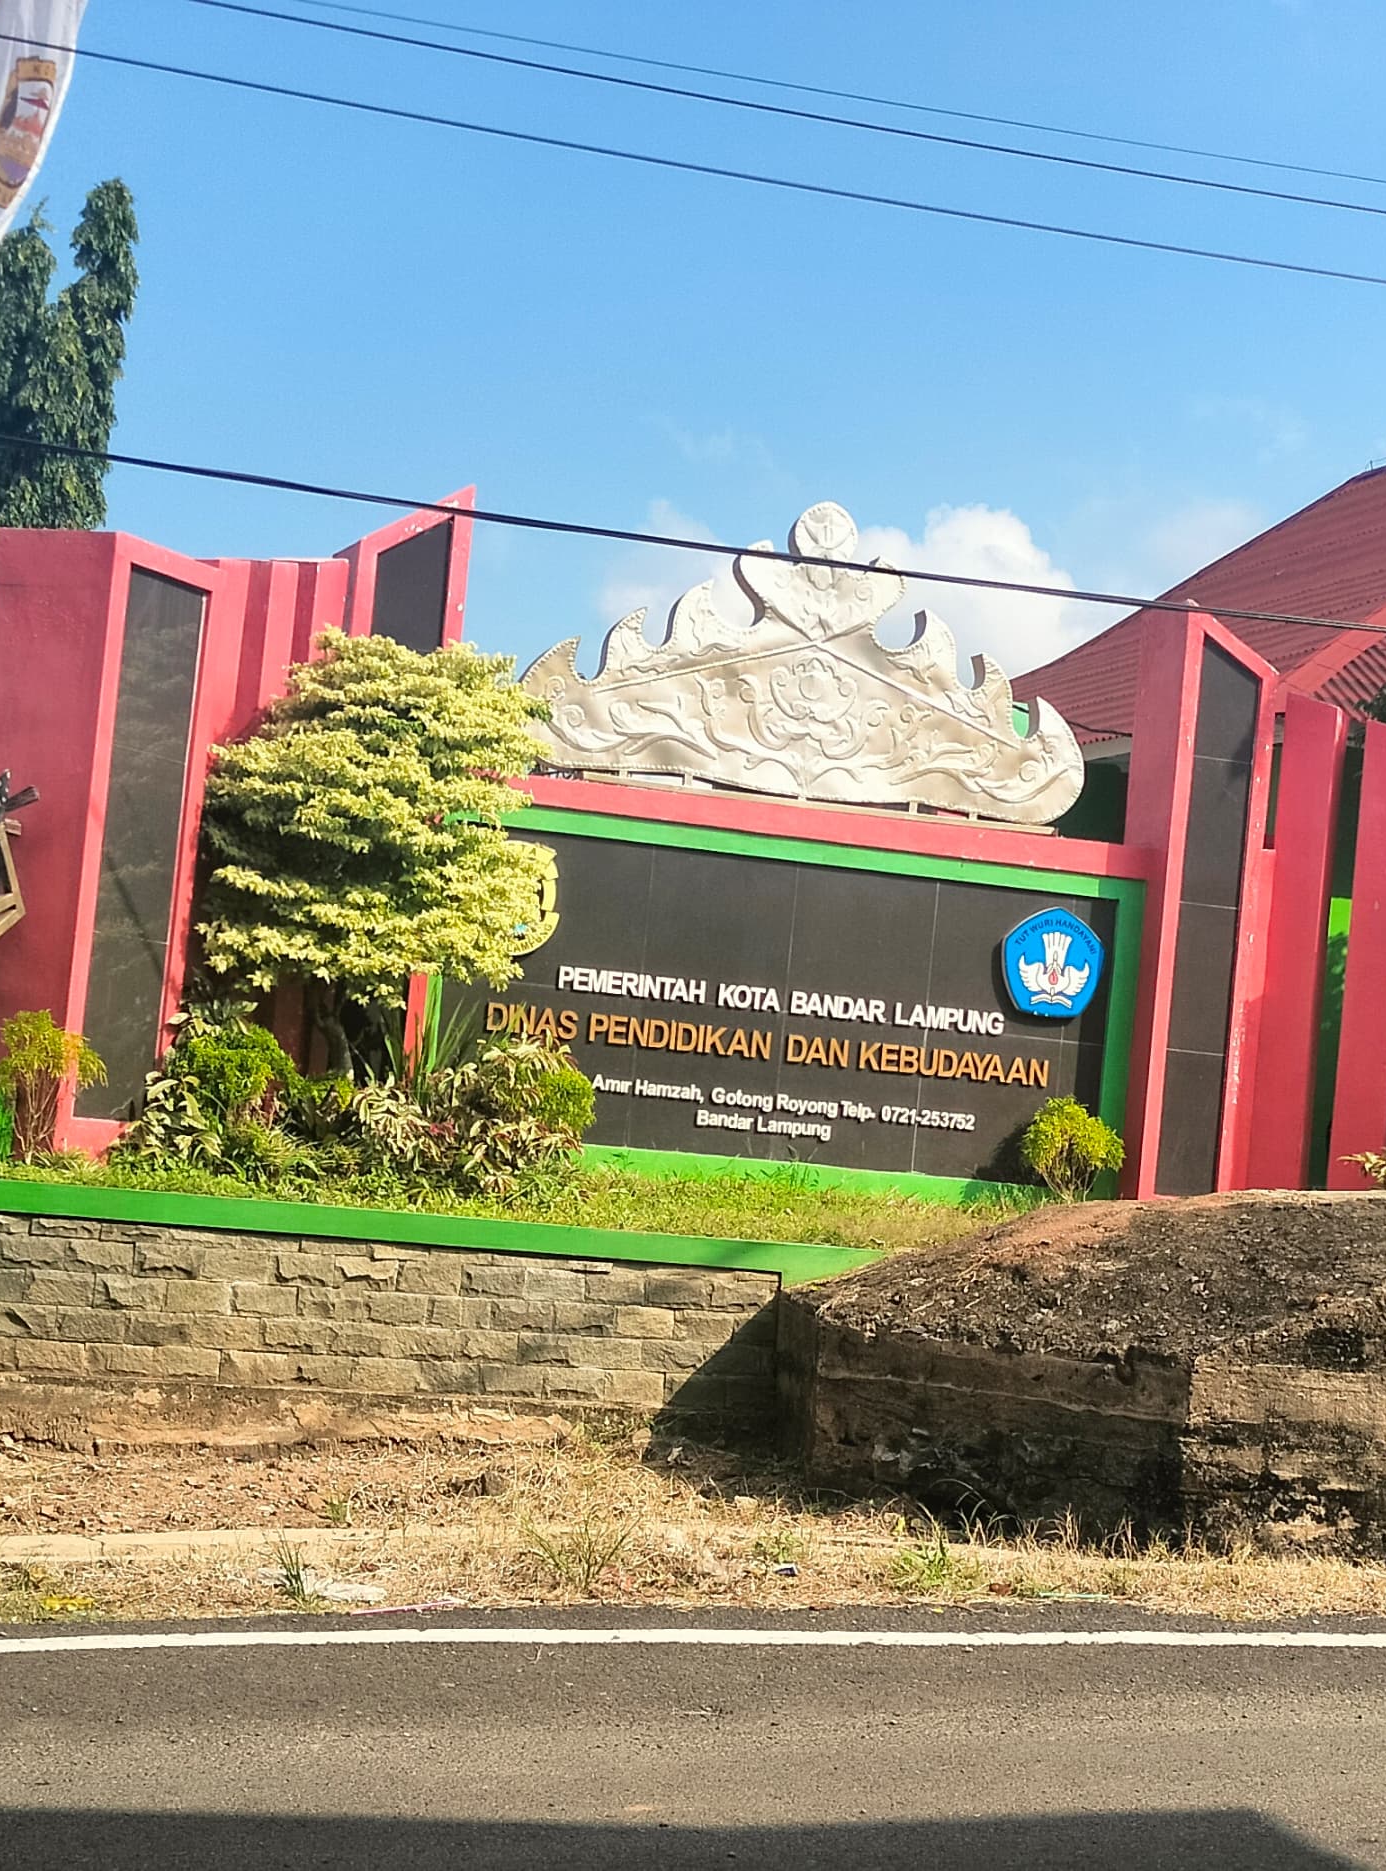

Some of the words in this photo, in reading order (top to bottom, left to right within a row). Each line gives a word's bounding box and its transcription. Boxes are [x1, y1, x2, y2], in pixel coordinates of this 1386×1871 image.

[1015, 930, 1030, 945] TUT
[1029, 920, 1053, 933] WURI
[1055, 919, 1098, 955] HANDAYANI
[557, 965, 706, 1004] PEMERINTAH
[718, 983, 781, 1013] KOTA
[790, 990, 886, 1024] BANDAR
[894, 1002, 1005, 1035] LAMPUNG
[486, 1002, 578, 1041] DINAS
[589, 1012, 772, 1060] PENDIDIKAN
[786, 1034, 850, 1068] DAN
[859, 1040, 1050, 1088] KEBUDAYAAN
[634, 1078, 705, 1105] Hamzah,
[711, 1087, 774, 1113] Gotong
[776, 1093, 839, 1120] Royong
[881, 1105, 976, 1132] 0721-253752
[696, 1109, 755, 1132] Bandar
[757, 1115, 832, 1142] Lampung
